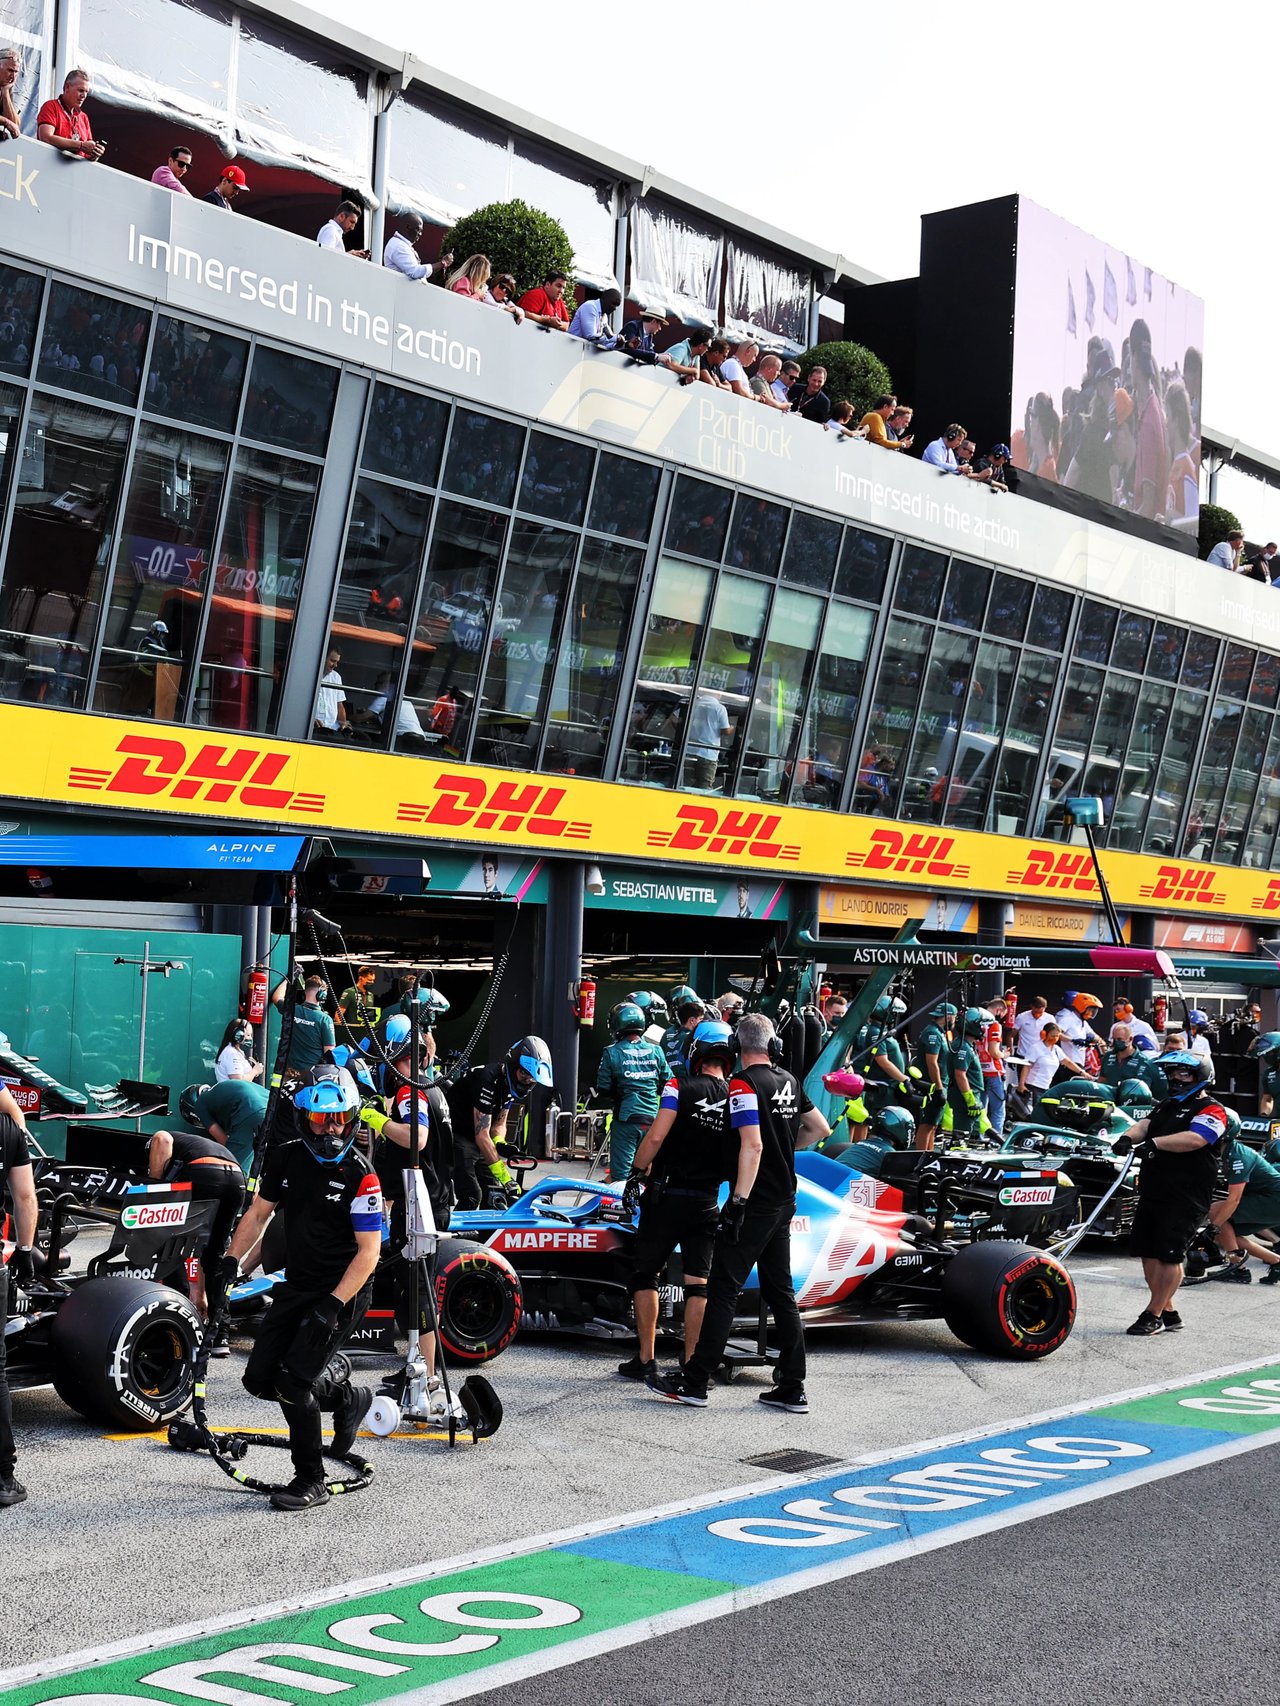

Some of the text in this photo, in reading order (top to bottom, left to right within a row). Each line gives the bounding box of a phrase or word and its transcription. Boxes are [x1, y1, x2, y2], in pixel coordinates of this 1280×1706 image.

[129, 224, 482, 377] Immersed in the action
[699, 398, 792, 460] Paddock
[698, 438, 746, 480] Club
[834, 465, 1019, 549] Immersed in the action
[108, 736, 293, 808] DHL
[427, 776, 566, 835] DHL
[206, 842, 277, 854] ALPINE
[671, 806, 780, 857] DHL
[232, 856, 253, 864] TEAM
[865, 830, 953, 875] DHL
[1023, 851, 1095, 890] DHL
[613, 881, 675, 900] SEBASTIAN
[676, 886, 717, 904] VETTEL
[1154, 867, 1215, 902] DHL
[841, 899, 874, 915] LANDO
[875, 901, 908, 917] NORRIS
[1019, 913, 1084, 931] DANIEL RICCIARDO
[854, 948, 1030, 969] ASTON MARTIN Cognizant
[850, 1180, 875, 1209] 31
[1013, 1189, 1052, 1203] Castrol
[139, 1206, 184, 1225] Castrol
[504, 1232, 598, 1249] MAPFRE
[1006, 1256, 1040, 1284] PIRELLI
[165, 1300, 204, 1346] ZERO
[499, 1292, 521, 1349] ZERO
[706, 1436, 1151, 1549] aramco
